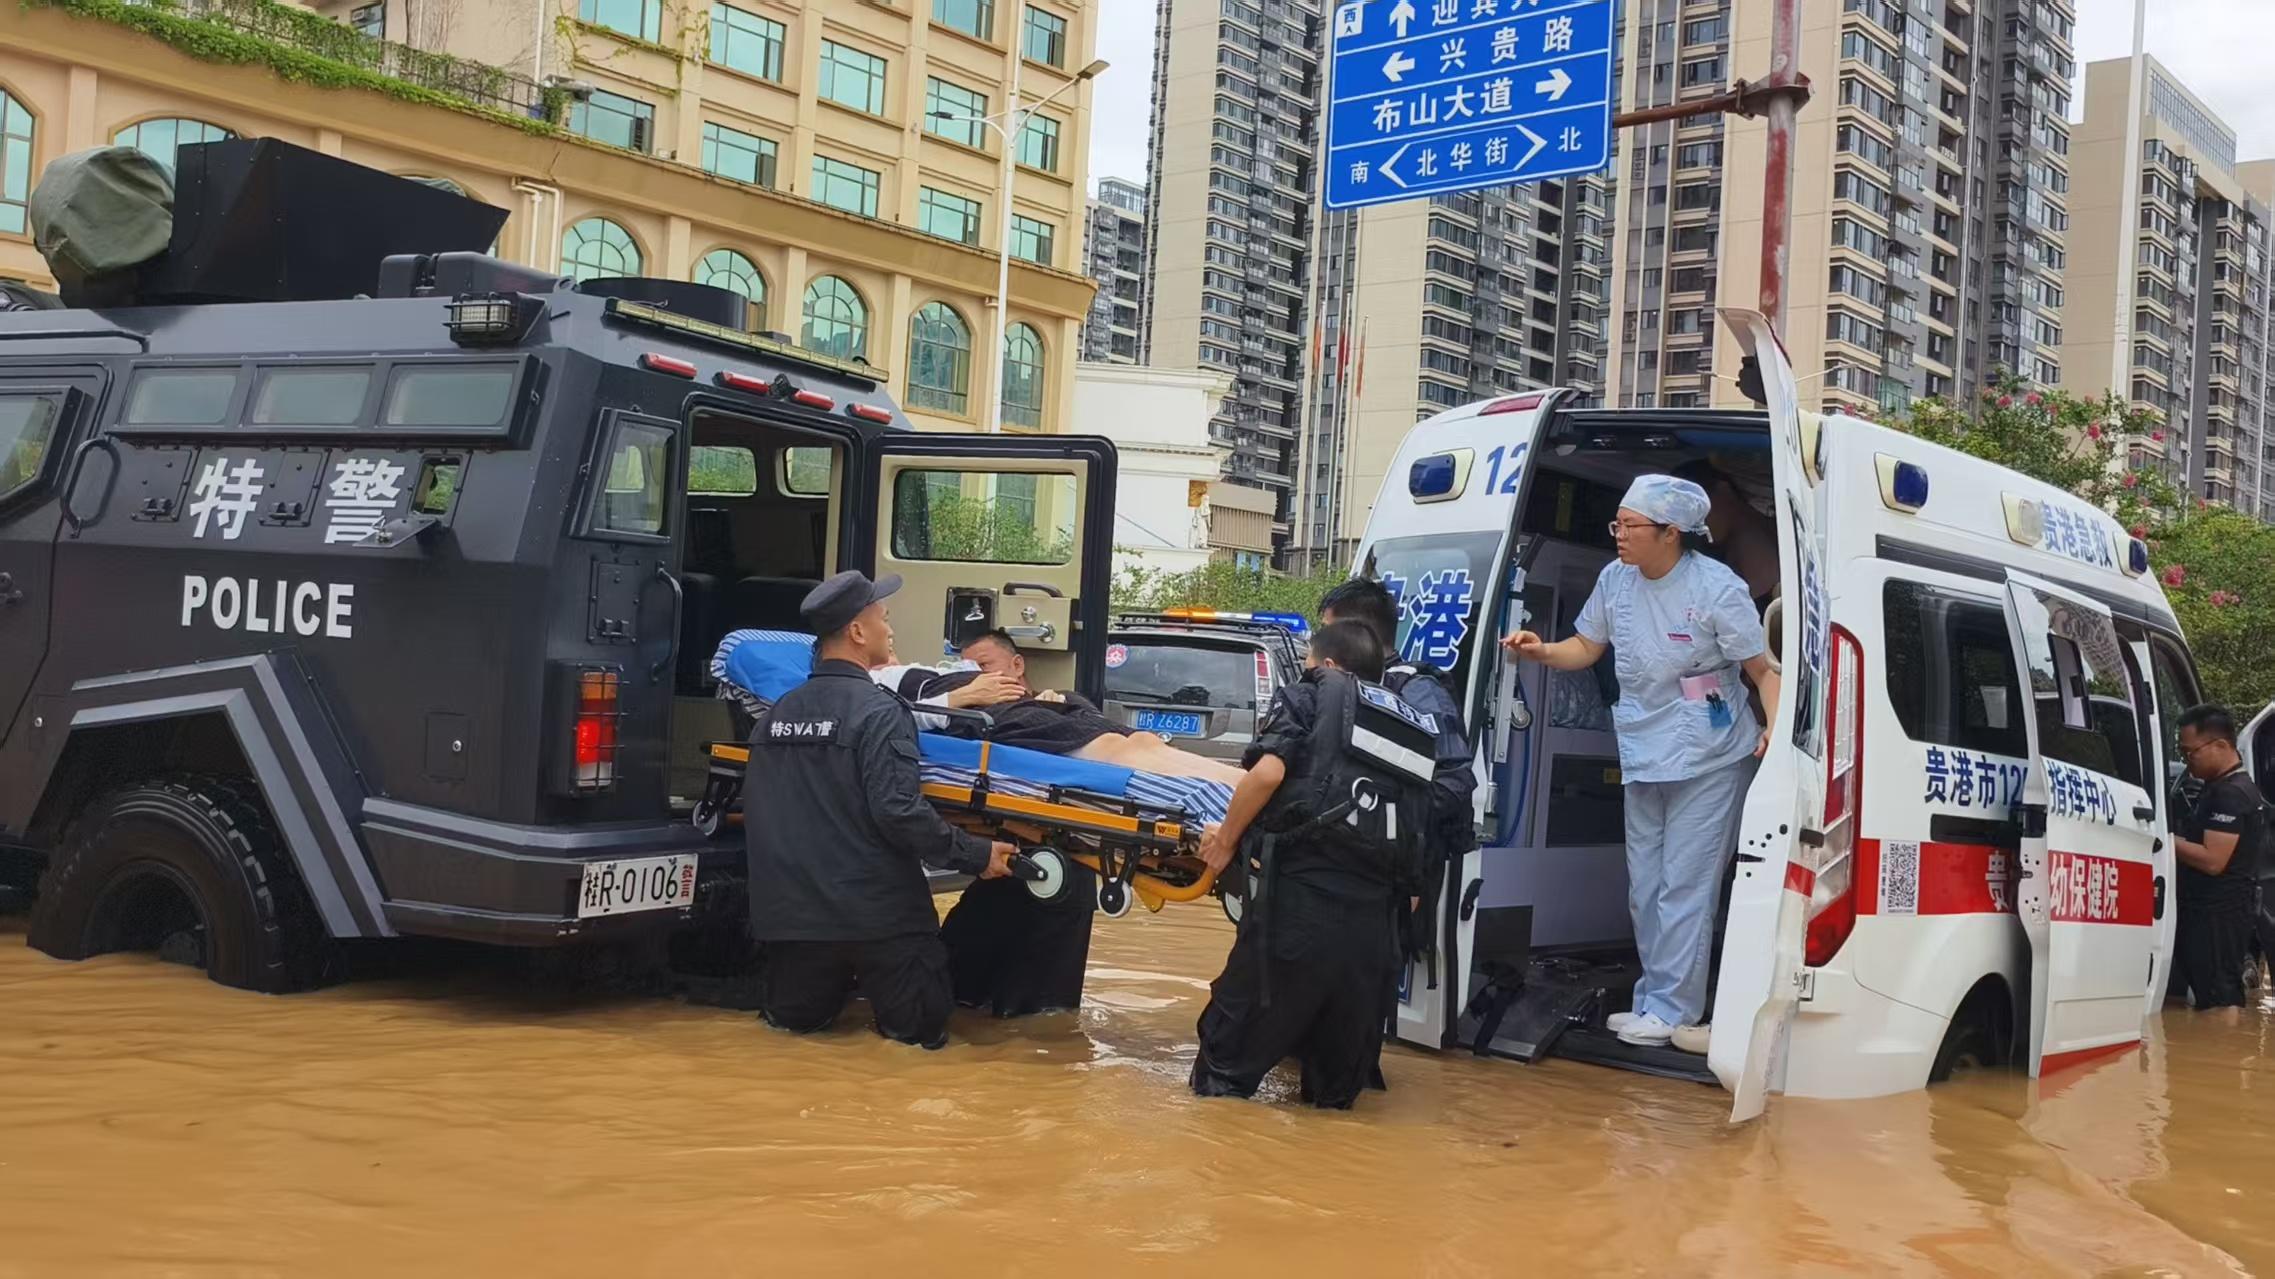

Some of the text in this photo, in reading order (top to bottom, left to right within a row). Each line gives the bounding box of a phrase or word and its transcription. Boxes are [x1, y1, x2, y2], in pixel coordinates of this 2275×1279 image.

[1440, 15, 1574, 73] 兴贵路
[1372, 77, 1513, 133] 布山大道
[1350, 126, 1582, 185] 南 北华街 北
[2041, 500, 2113, 568] 贵港急救
[181, 575, 355, 639] POLICE
[1924, 746, 2117, 826] 贵港市12 指挥中心
[2050, 853, 2119, 920] 幼保健院
